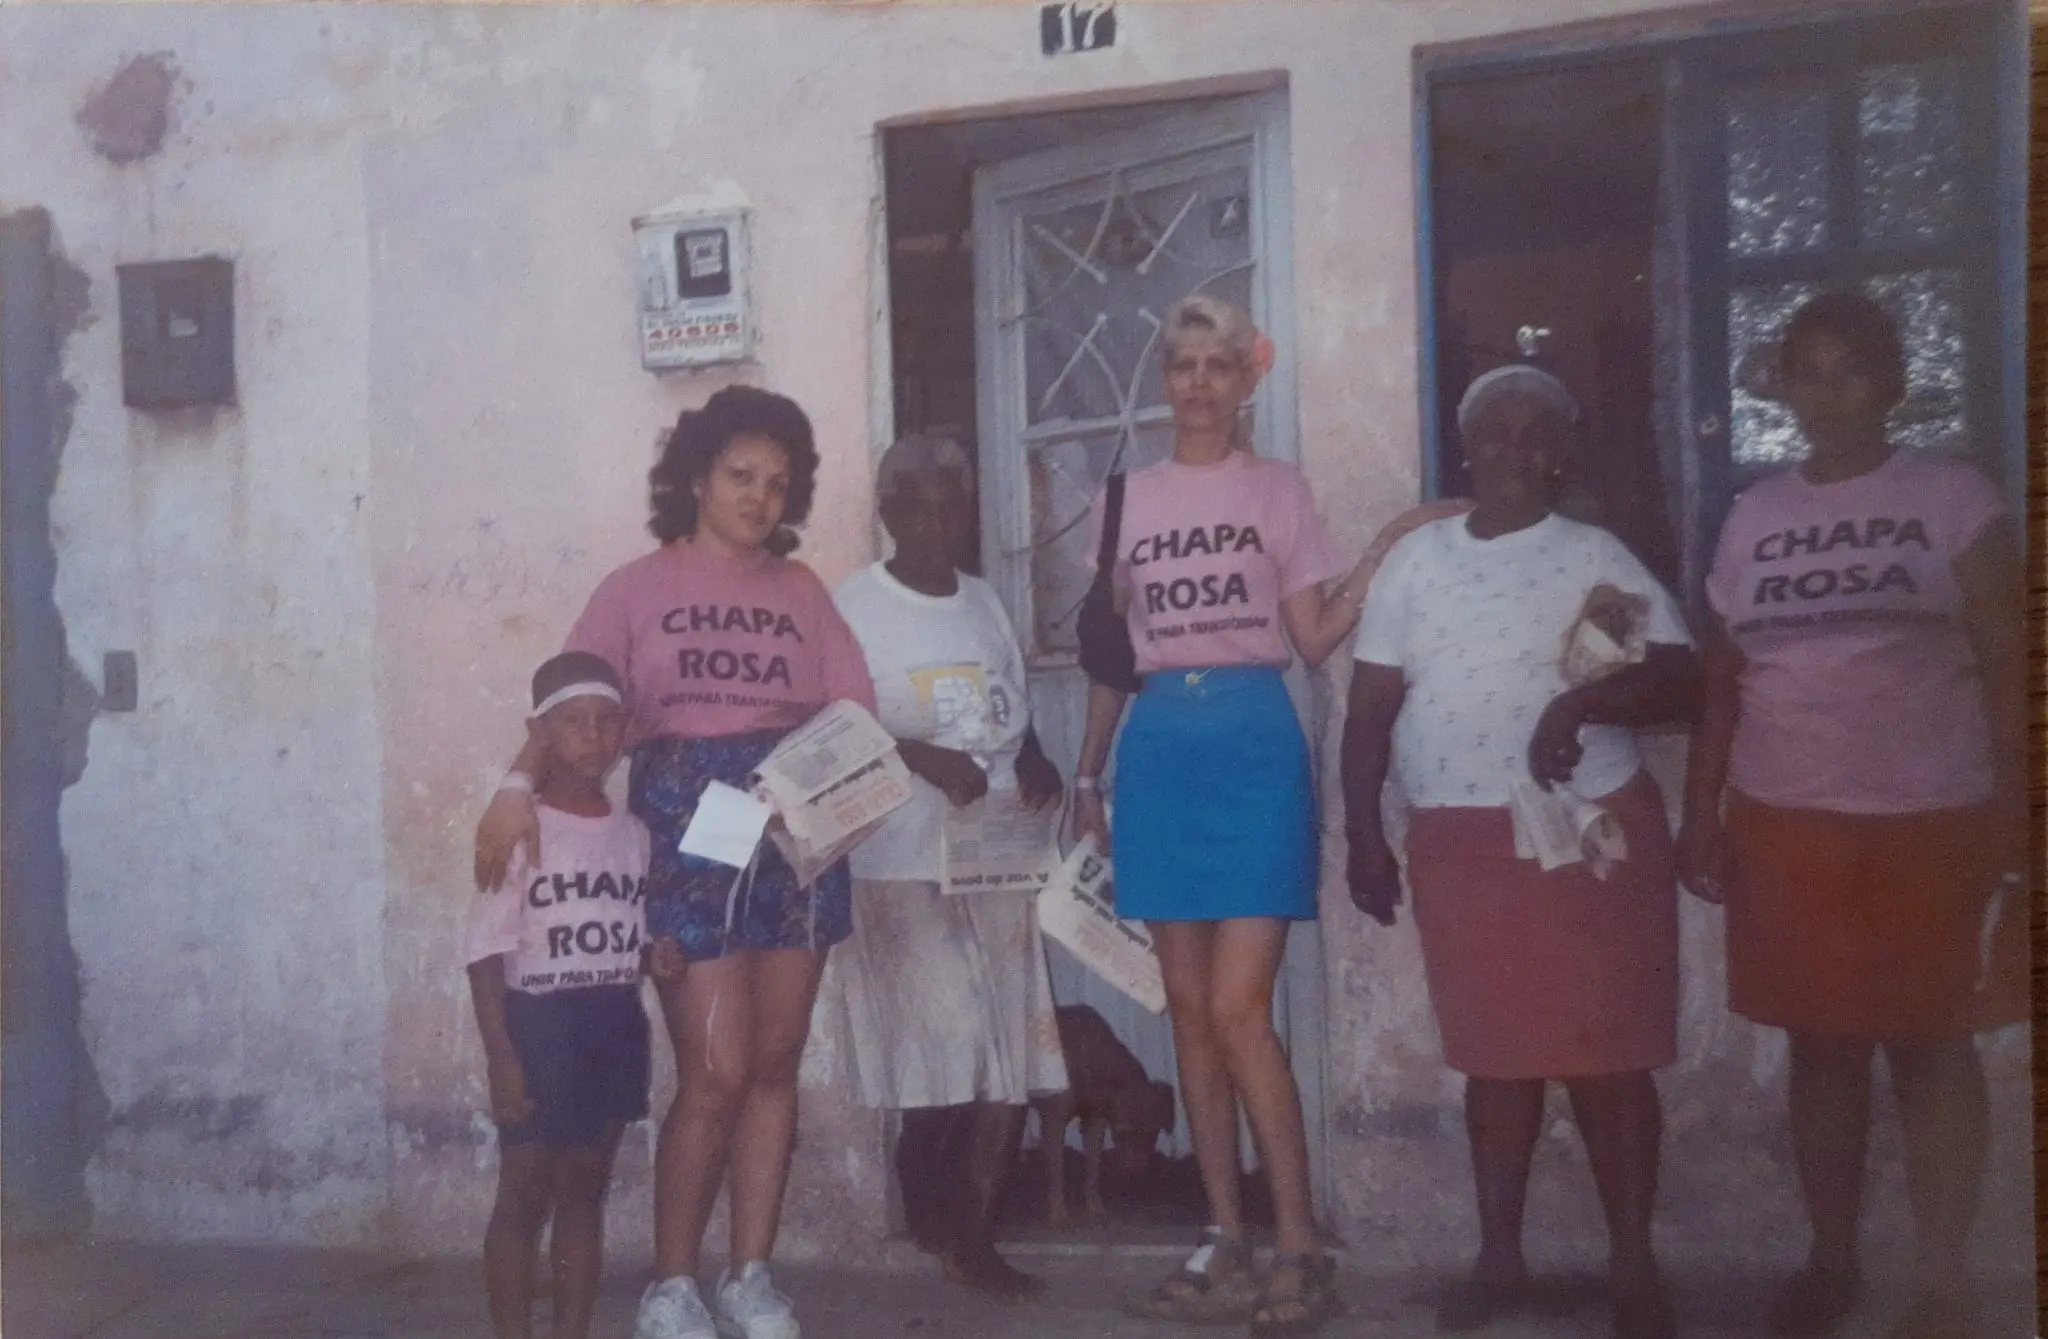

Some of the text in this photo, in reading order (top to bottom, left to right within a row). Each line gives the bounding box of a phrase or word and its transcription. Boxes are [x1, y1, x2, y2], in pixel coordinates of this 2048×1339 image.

[1059, 2, 1114, 51] 17
[1130, 523, 1265, 566] CHAPA
[1753, 517, 1931, 562] CHAPA
[1145, 572, 1249, 614] ROSA
[1753, 563, 1917, 605] ROSA
[661, 604, 805, 643] CHAPA
[678, 648, 792, 688] ROSA
[521, 973, 557, 987] UNIR
[560, 970, 594, 984] PARA
